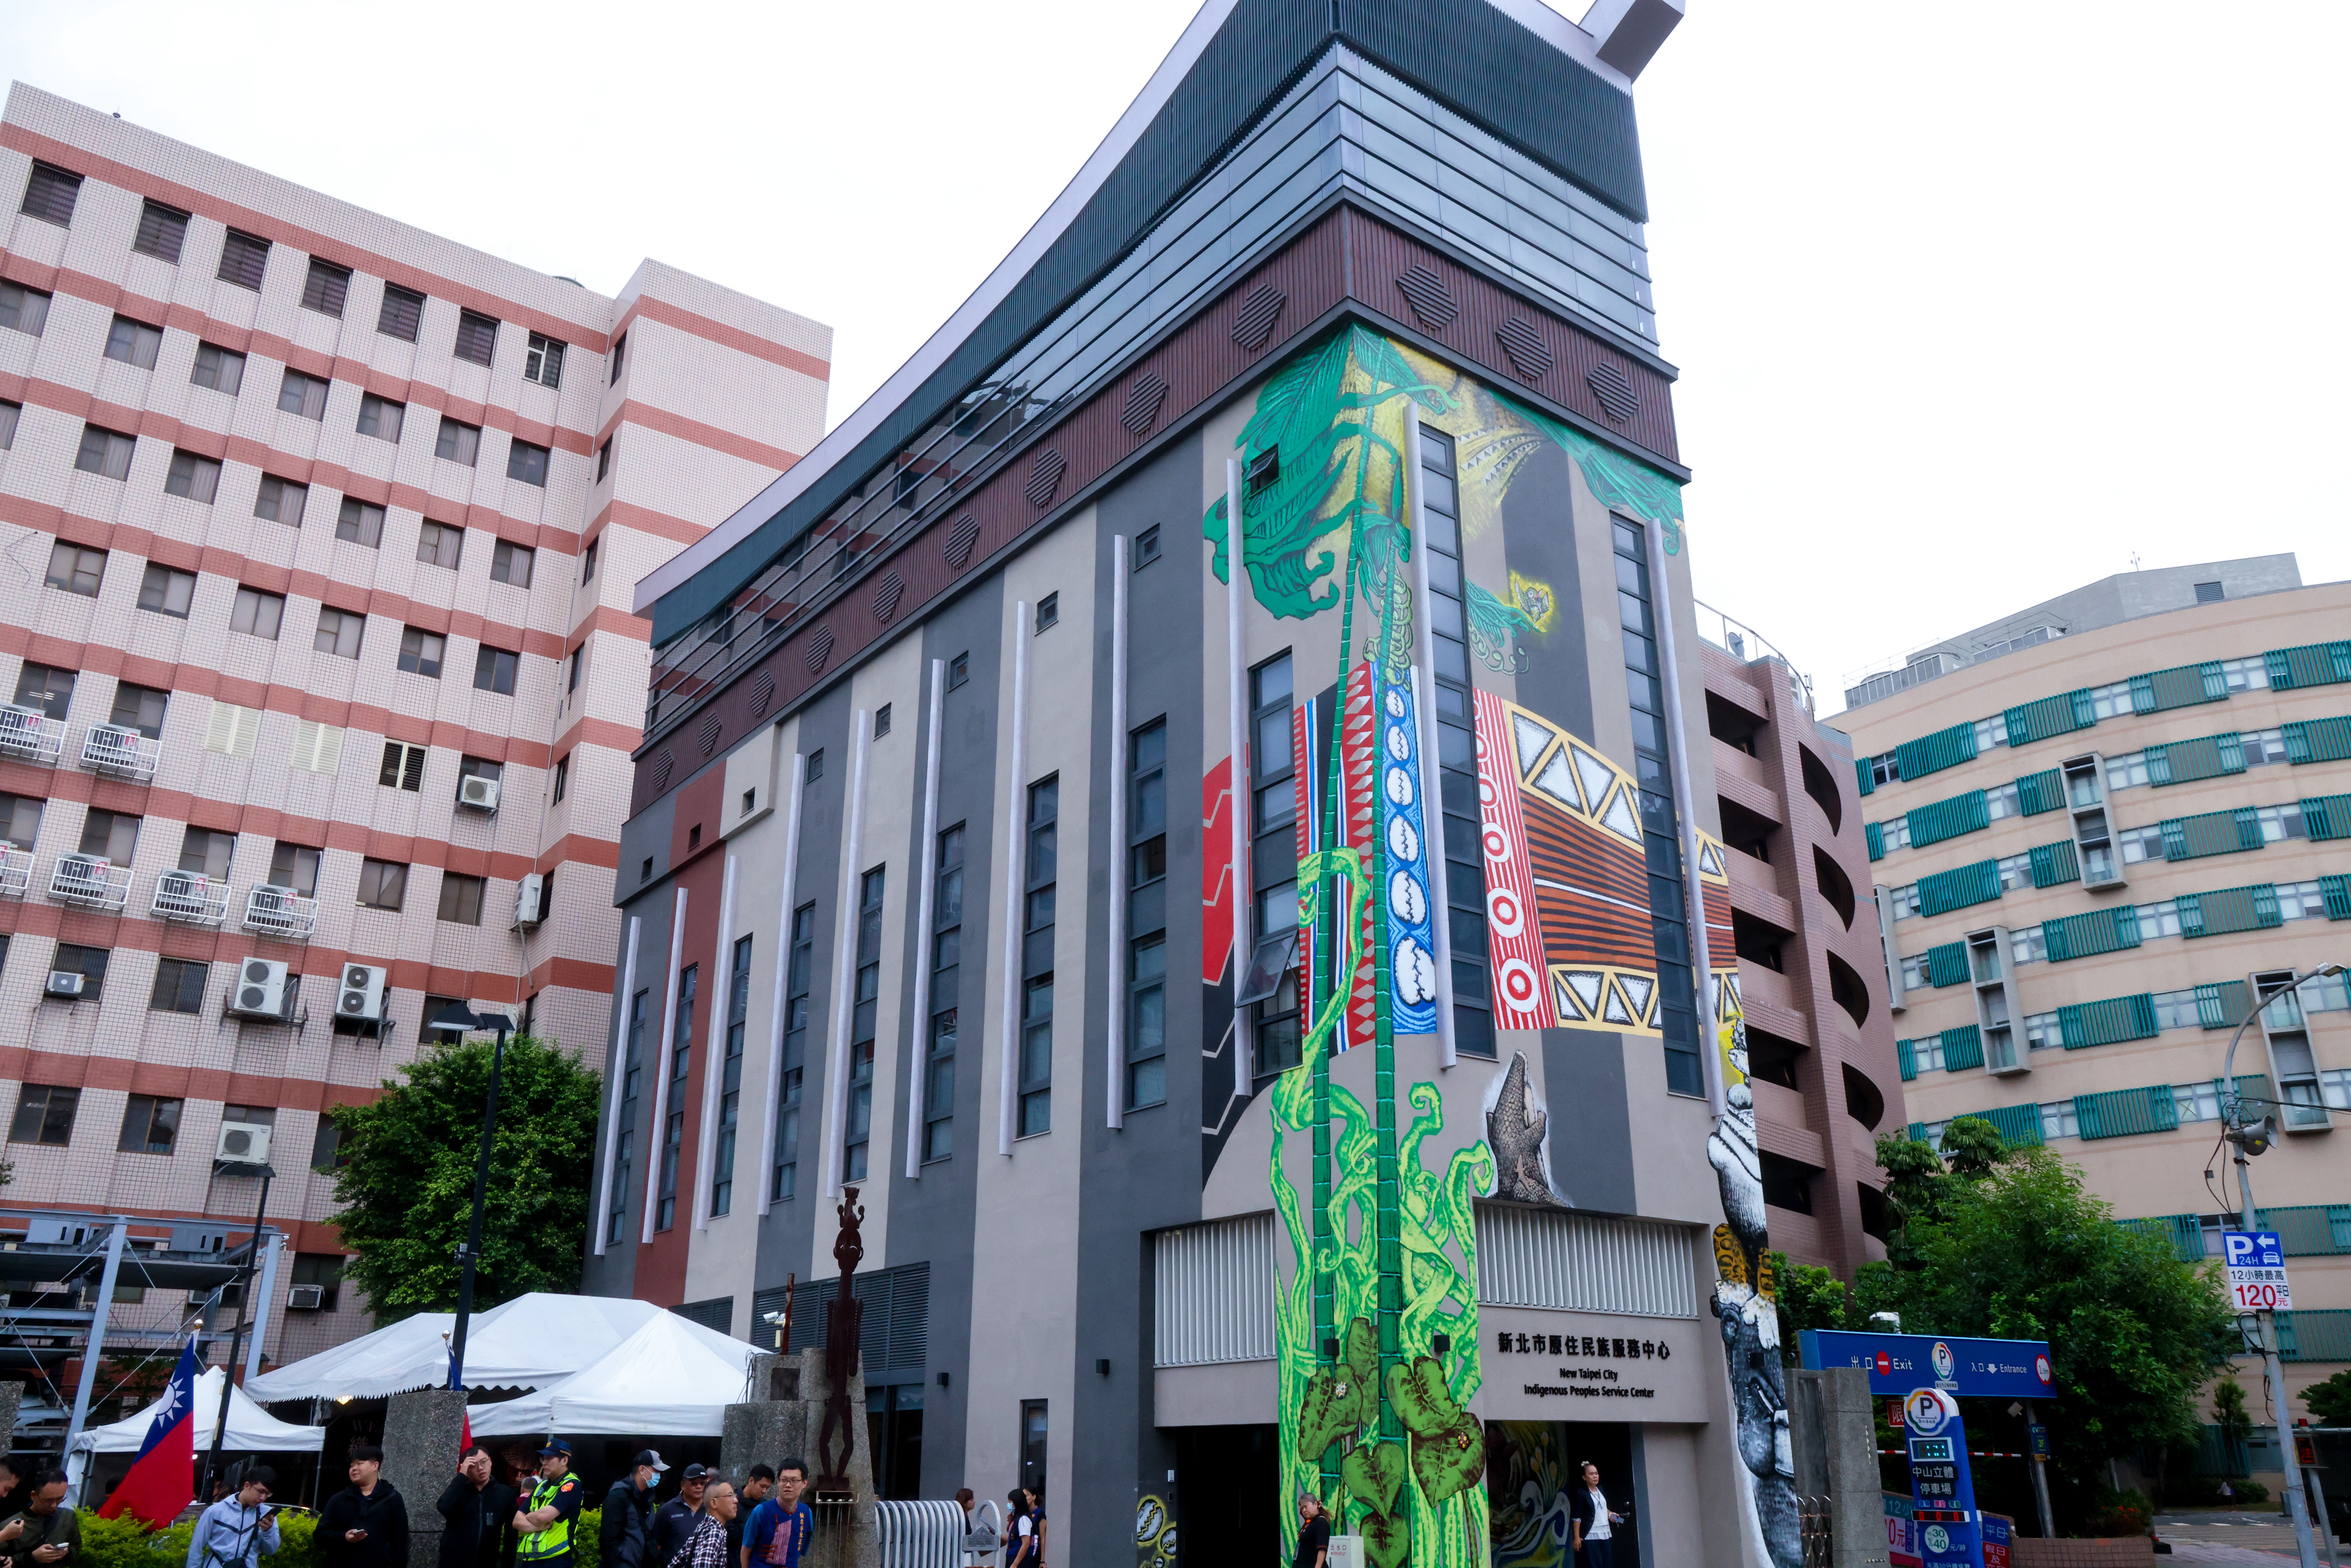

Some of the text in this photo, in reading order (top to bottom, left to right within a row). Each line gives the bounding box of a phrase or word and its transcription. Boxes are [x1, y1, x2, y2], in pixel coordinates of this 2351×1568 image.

[2226, 1236, 2253, 1264] P
[2239, 1256, 2259, 1264] 24H
[2231, 1270, 2284, 1280] 12小時最高
[2236, 1284, 2276, 1306] 120
[2276, 1285, 2289, 1297] 平日
[2278, 1298, 2288, 1306] 元
[1498, 1332, 1670, 1360] 新北市原住民族服務中心
[1851, 1355, 1873, 1369] 出口
[1939, 1349, 1946, 1365] P
[1893, 1358, 1912, 1370] Exit
[1971, 1363, 1984, 1372] 入口
[2000, 1364, 2027, 1373] Entrance
[1559, 1368, 1618, 1382] New Taipei City
[1524, 1384, 1655, 1398] Indigenous Peoples Service Center
[1920, 1397, 1933, 1416] P
[1912, 1466, 1954, 1478] 中山立體
[1920, 1483, 1952, 1495] 停車場
[1933, 1529, 1945, 1538] 30
[1986, 1524, 2005, 1539] 平日
[1934, 1539, 1946, 1549] 40
